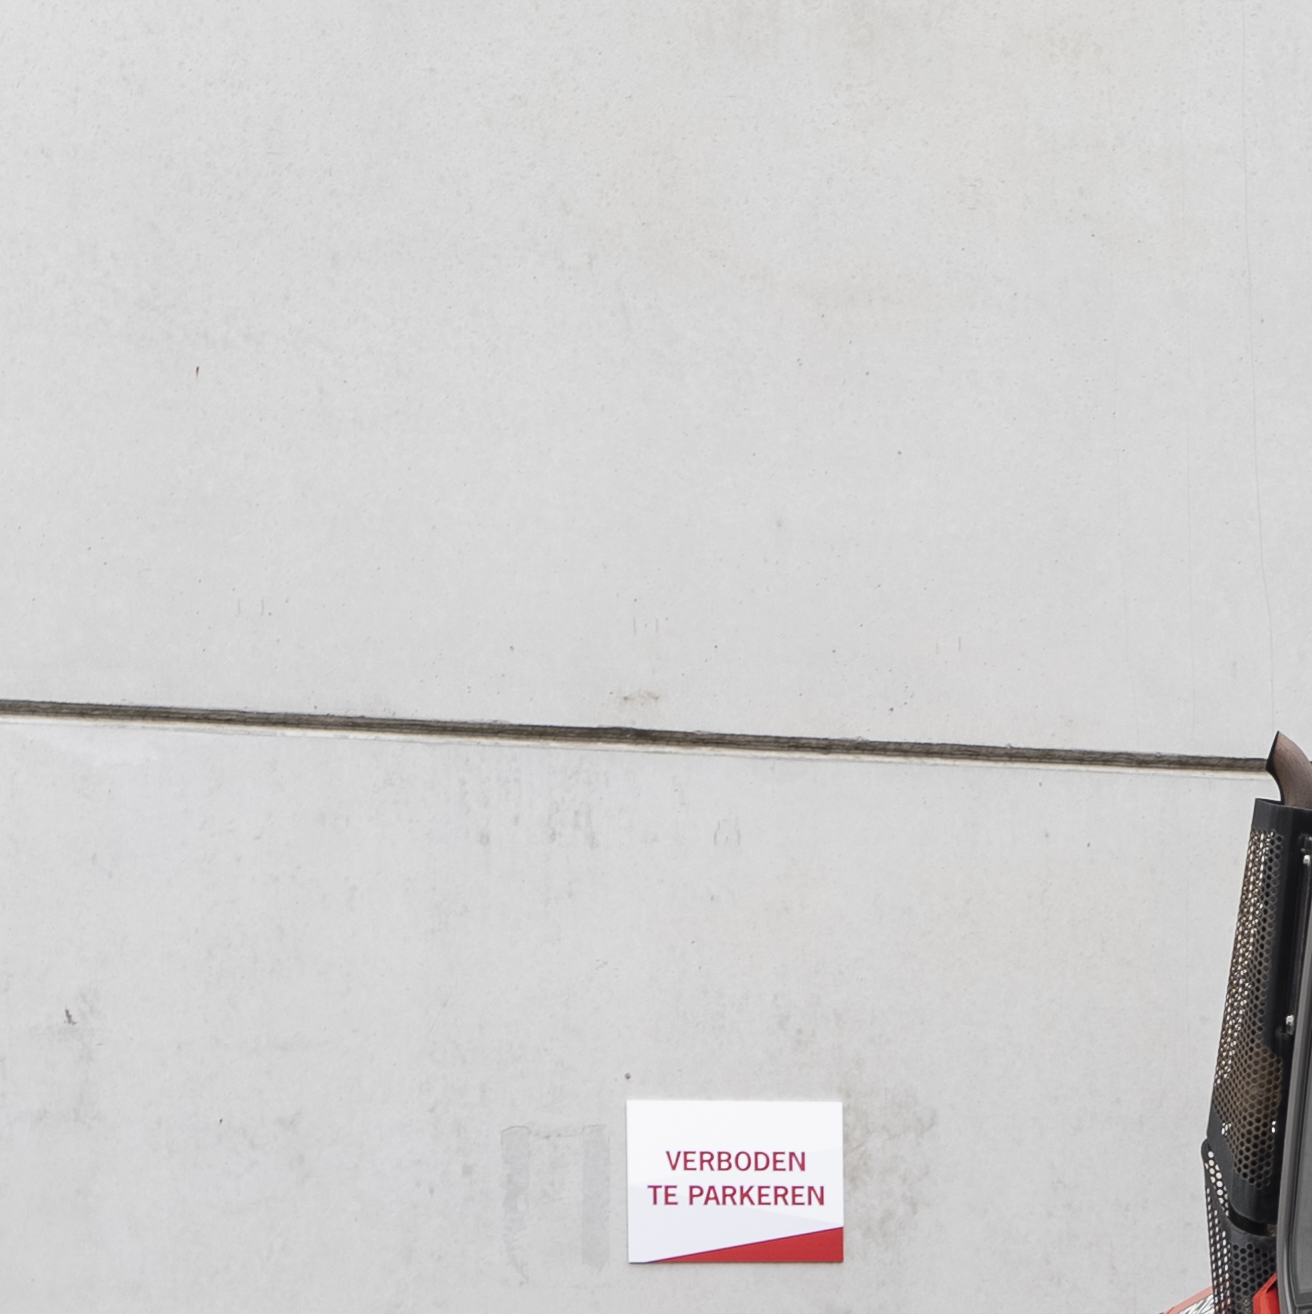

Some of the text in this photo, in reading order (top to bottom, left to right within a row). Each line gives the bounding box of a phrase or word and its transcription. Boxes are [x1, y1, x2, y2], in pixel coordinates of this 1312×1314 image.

[666, 1150, 806, 1172] VERBODEN
[647, 1184, 825, 1206] TE PARKEREN
